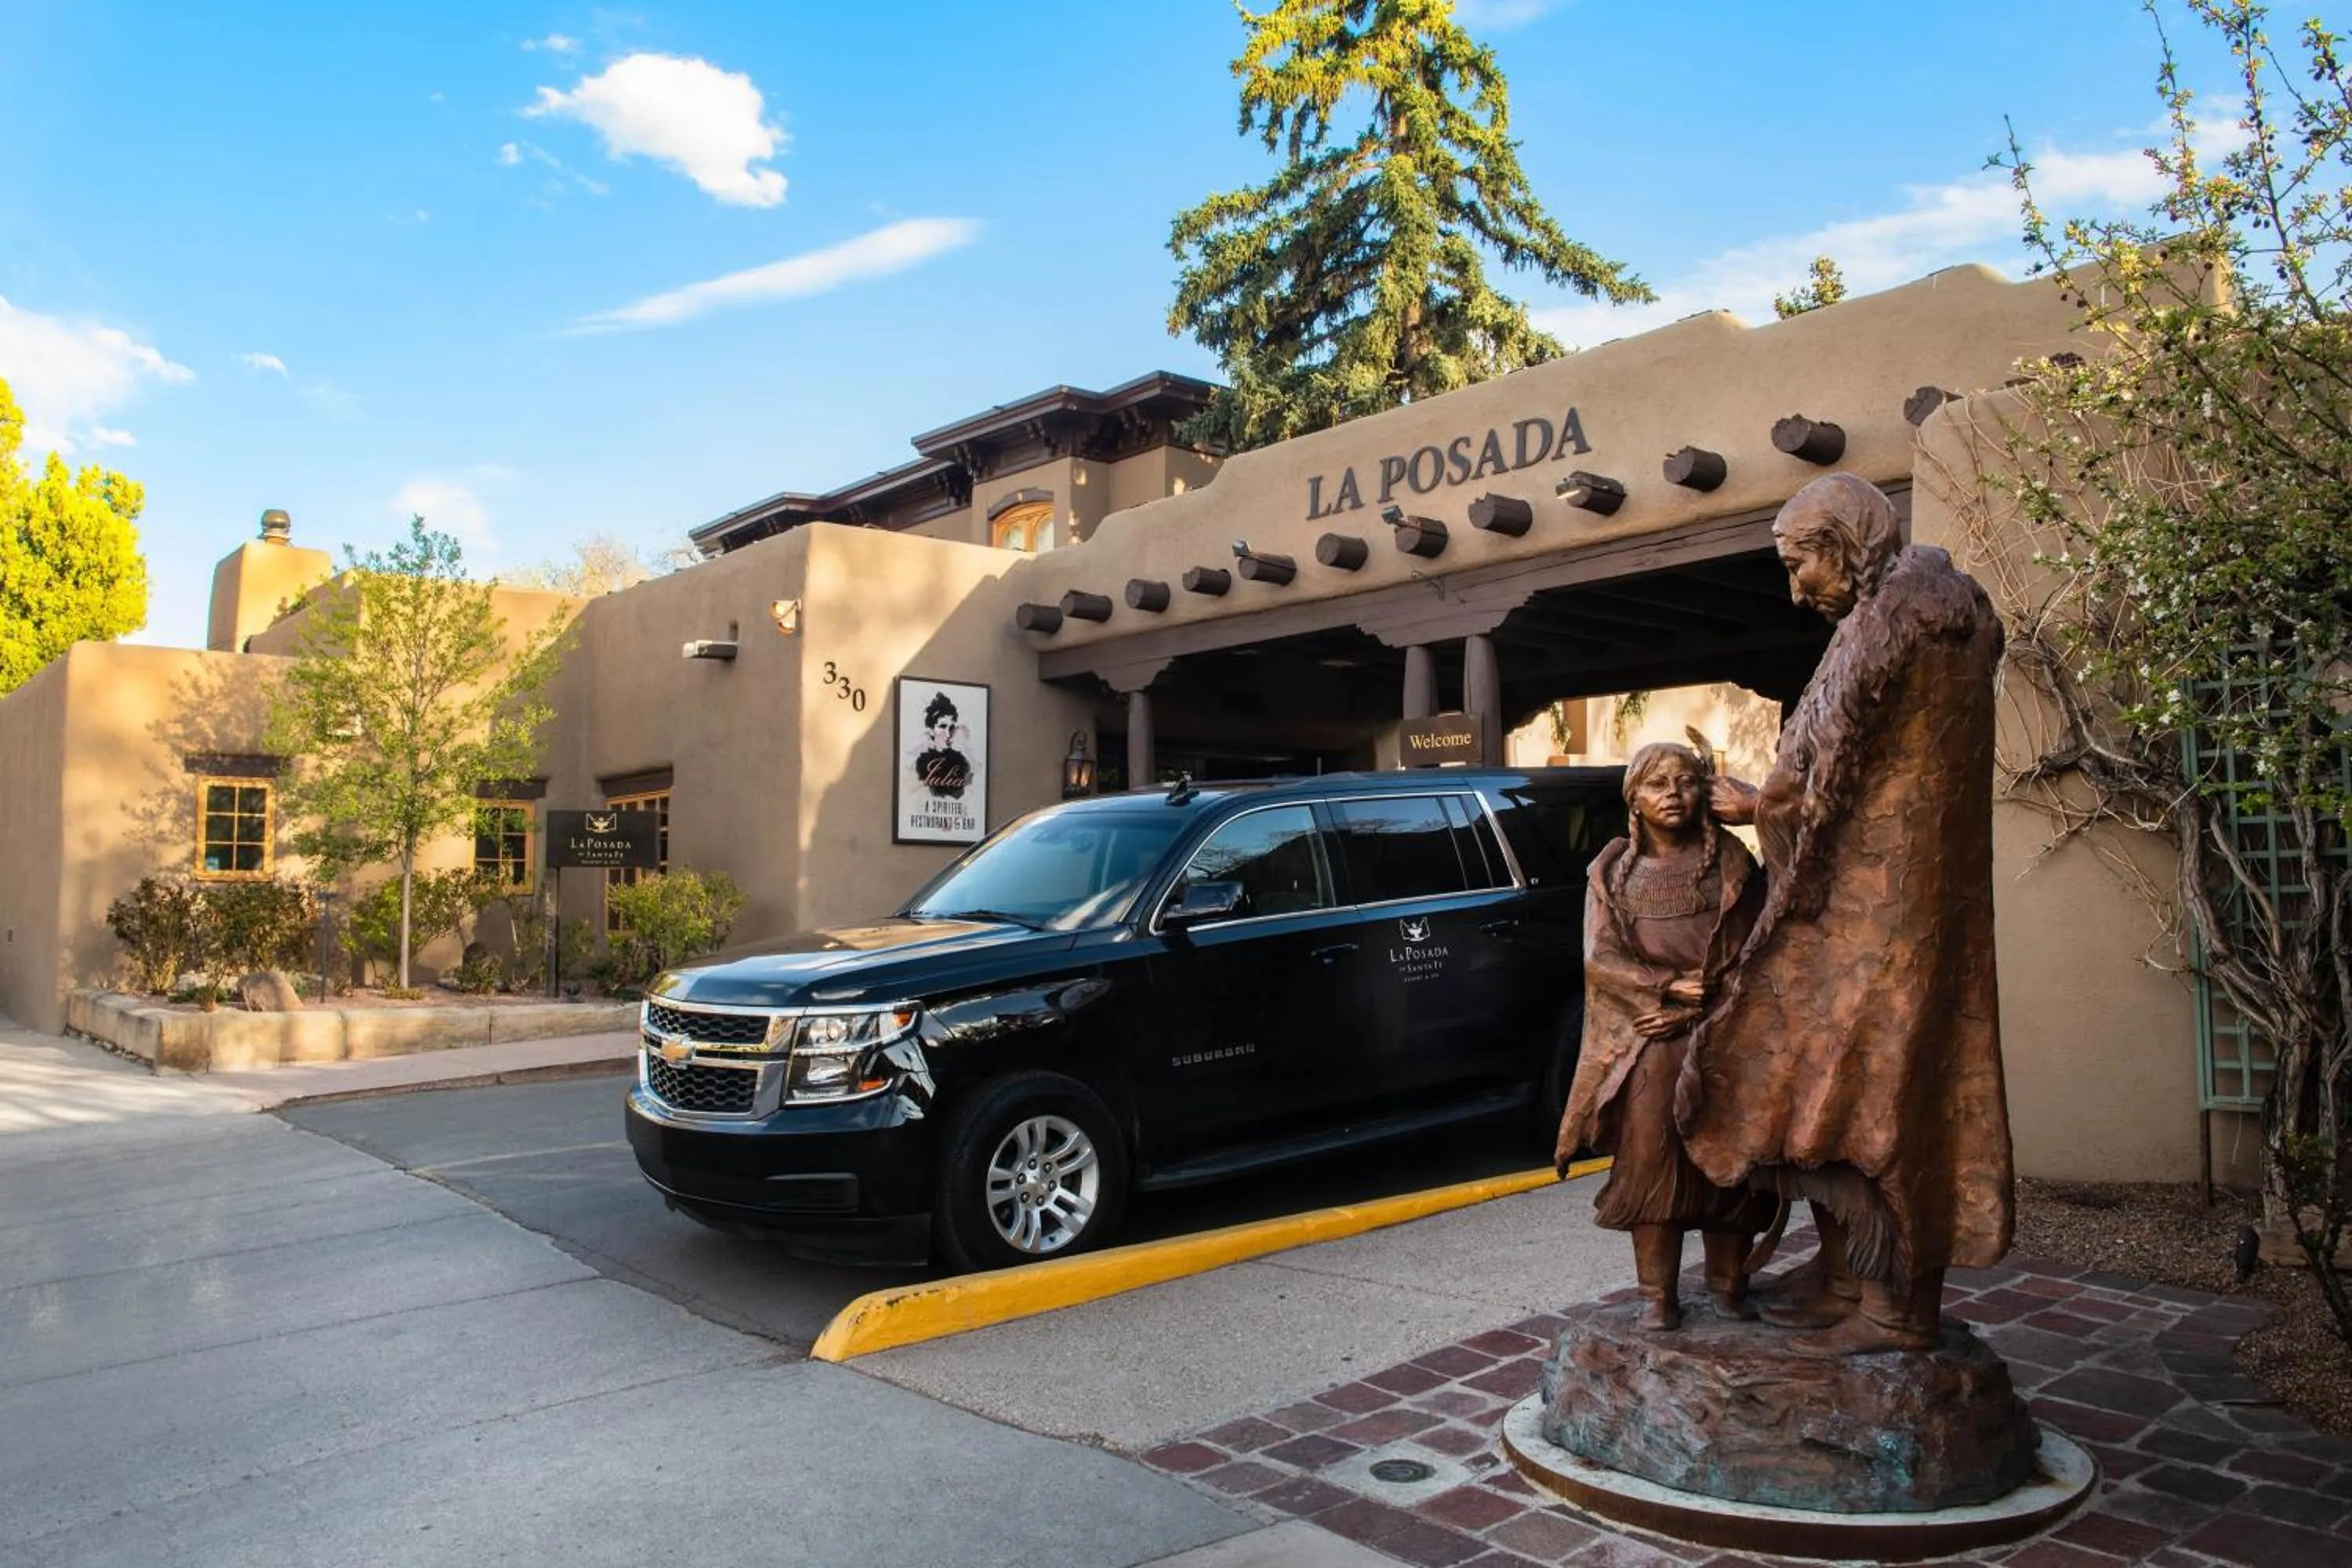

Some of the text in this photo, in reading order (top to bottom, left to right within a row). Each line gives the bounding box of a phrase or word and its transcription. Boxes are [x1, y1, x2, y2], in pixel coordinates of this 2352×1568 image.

[1305, 406, 1592, 521] LA POSADA
[822, 661, 866, 712] 330
[1409, 733, 1472, 750] Welcome
[922, 757, 966, 787] Julia
[1171, 1044, 1255, 1067] SUBURBAN
